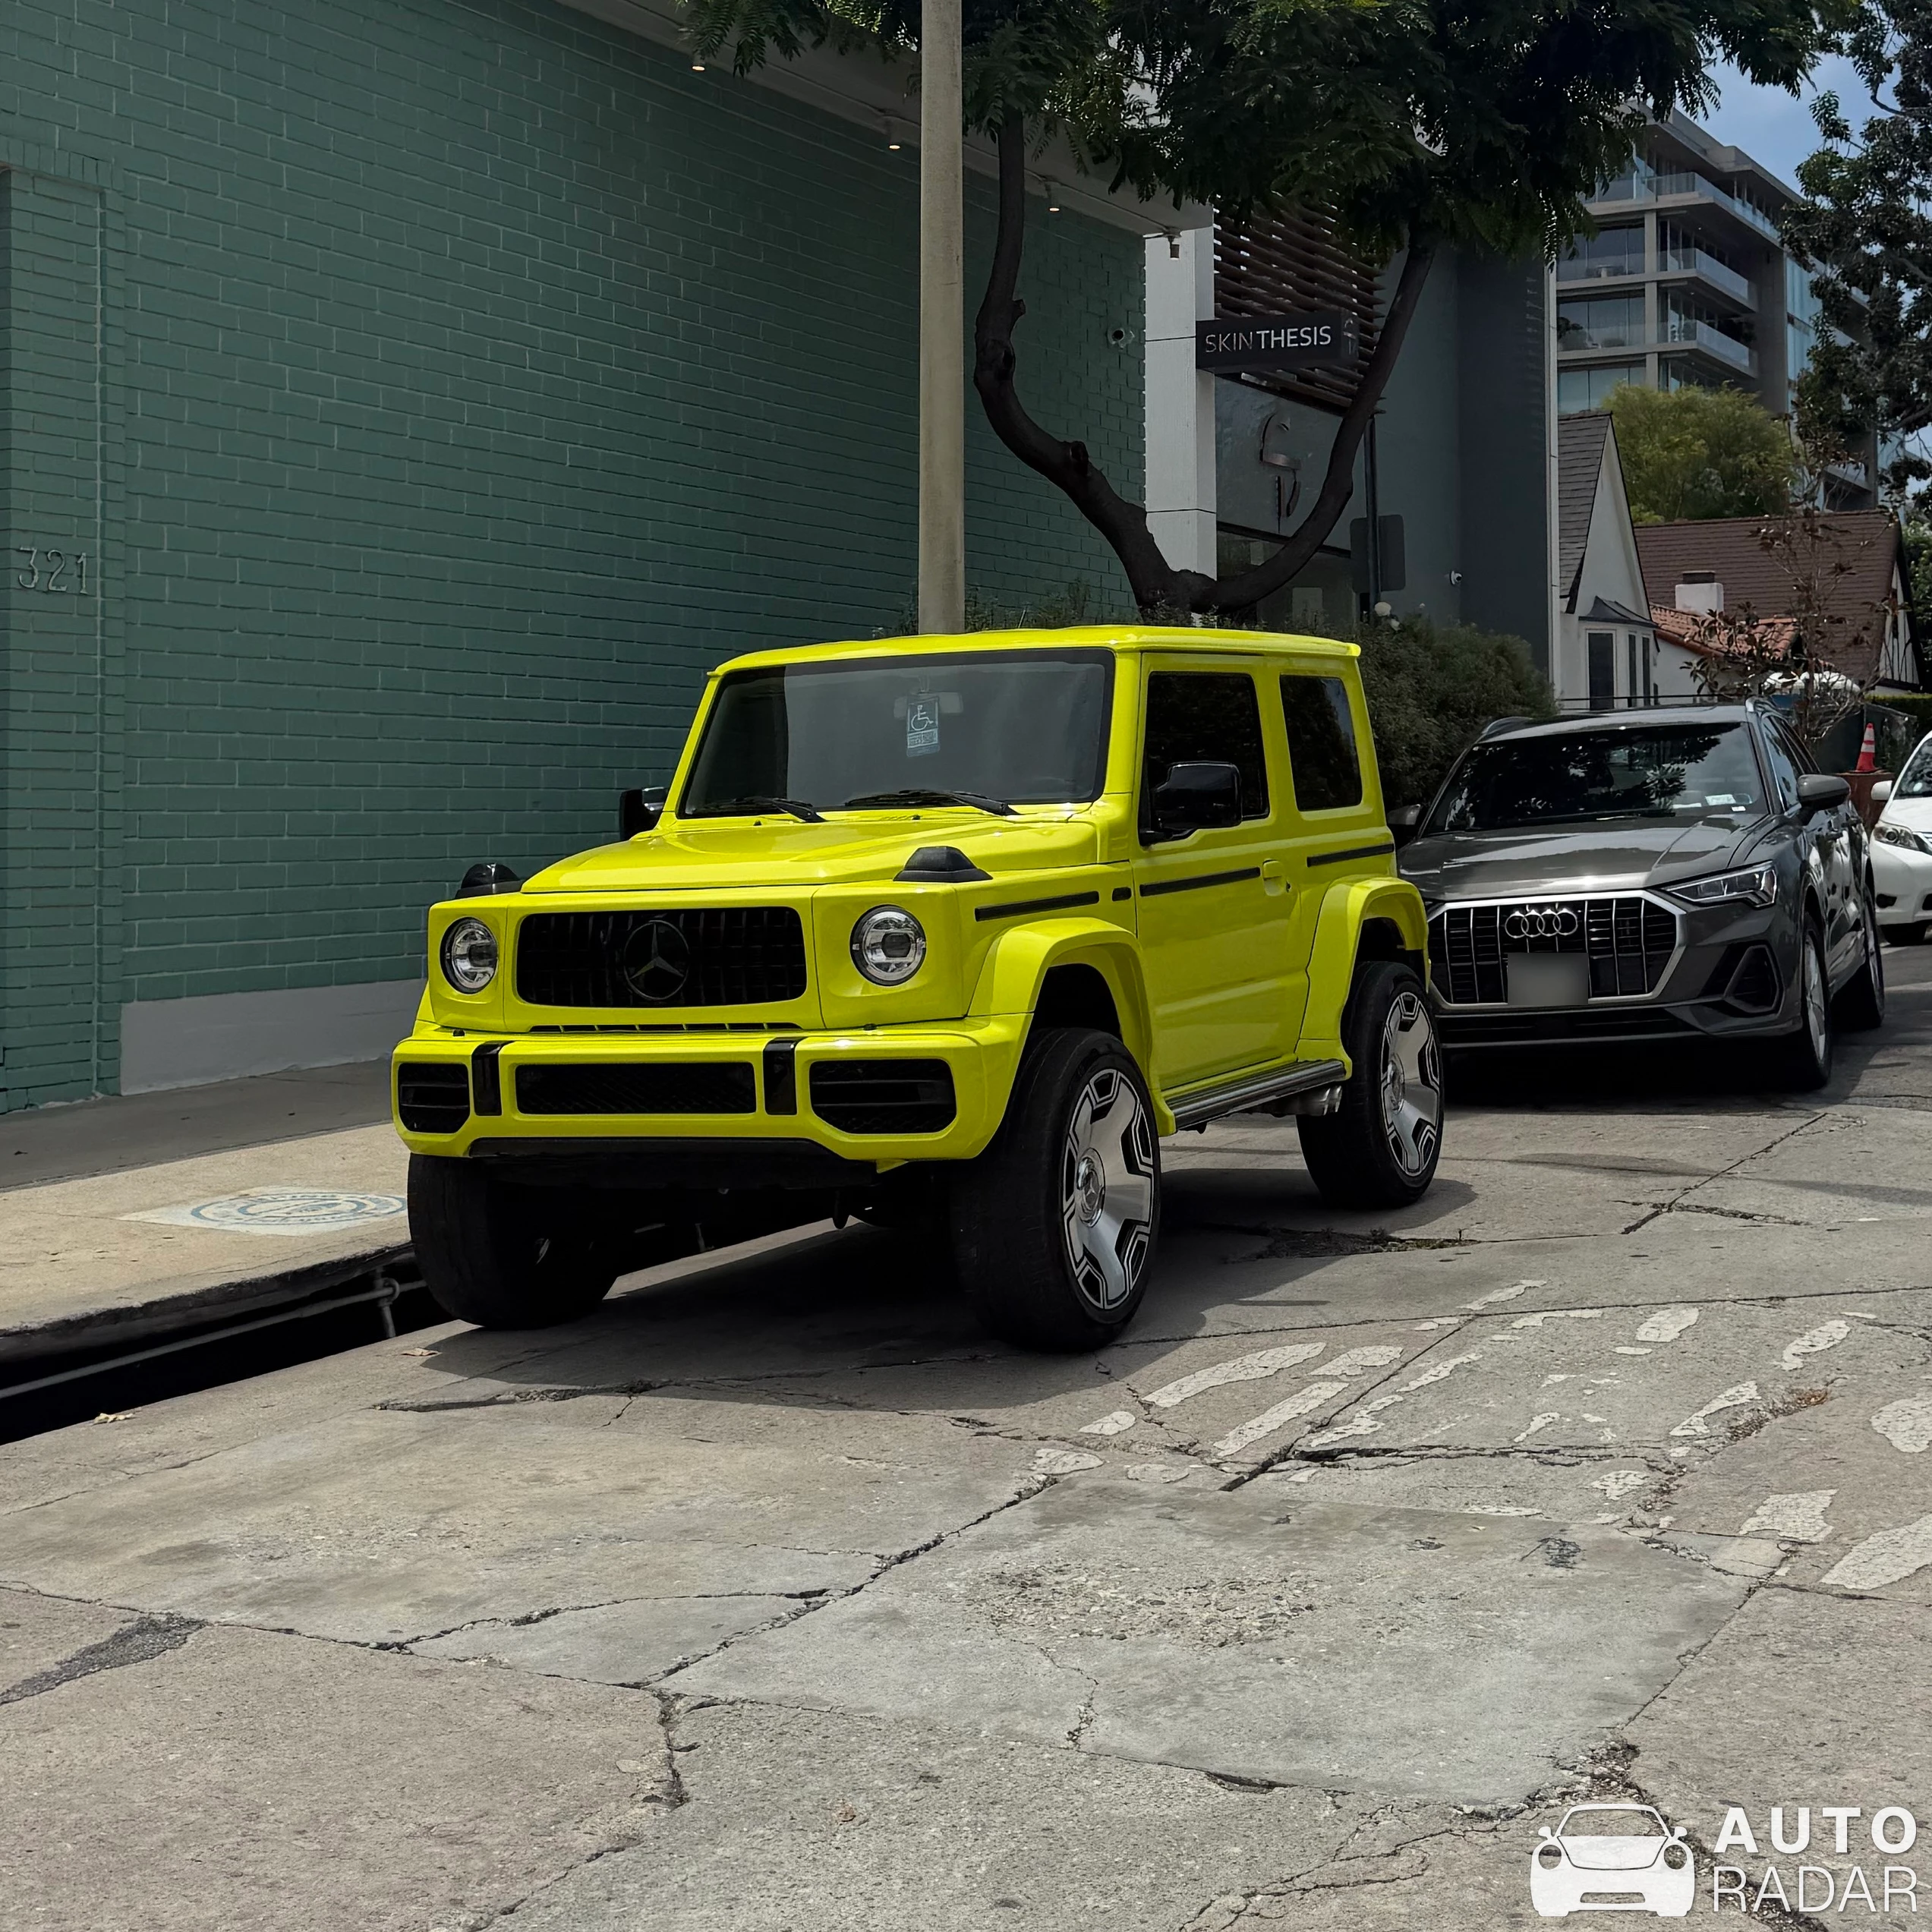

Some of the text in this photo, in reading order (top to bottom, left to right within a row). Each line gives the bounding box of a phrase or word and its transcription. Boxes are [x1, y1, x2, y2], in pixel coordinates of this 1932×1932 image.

[1205, 326, 1332, 353] SKIN THESIS
[18, 547, 88, 594] 321
